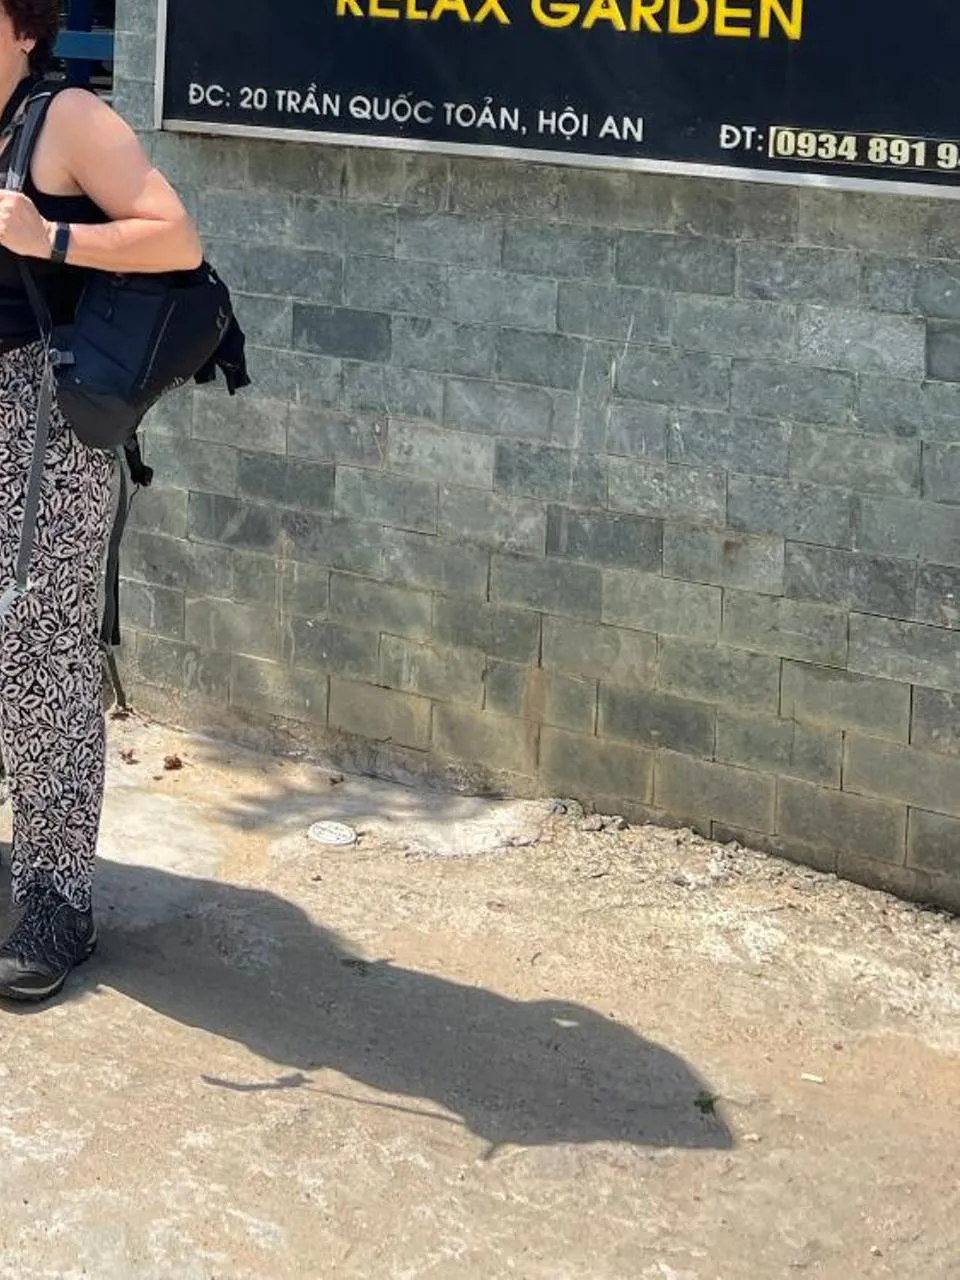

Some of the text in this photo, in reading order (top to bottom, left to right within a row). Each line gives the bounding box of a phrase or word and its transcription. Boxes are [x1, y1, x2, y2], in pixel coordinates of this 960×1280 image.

[189, 82, 644, 142] ĐC: 20 TRẦN QUỐC TOẢN, HỘI AN
[719, 124, 960, 170] ĐT: 0934 891 9
